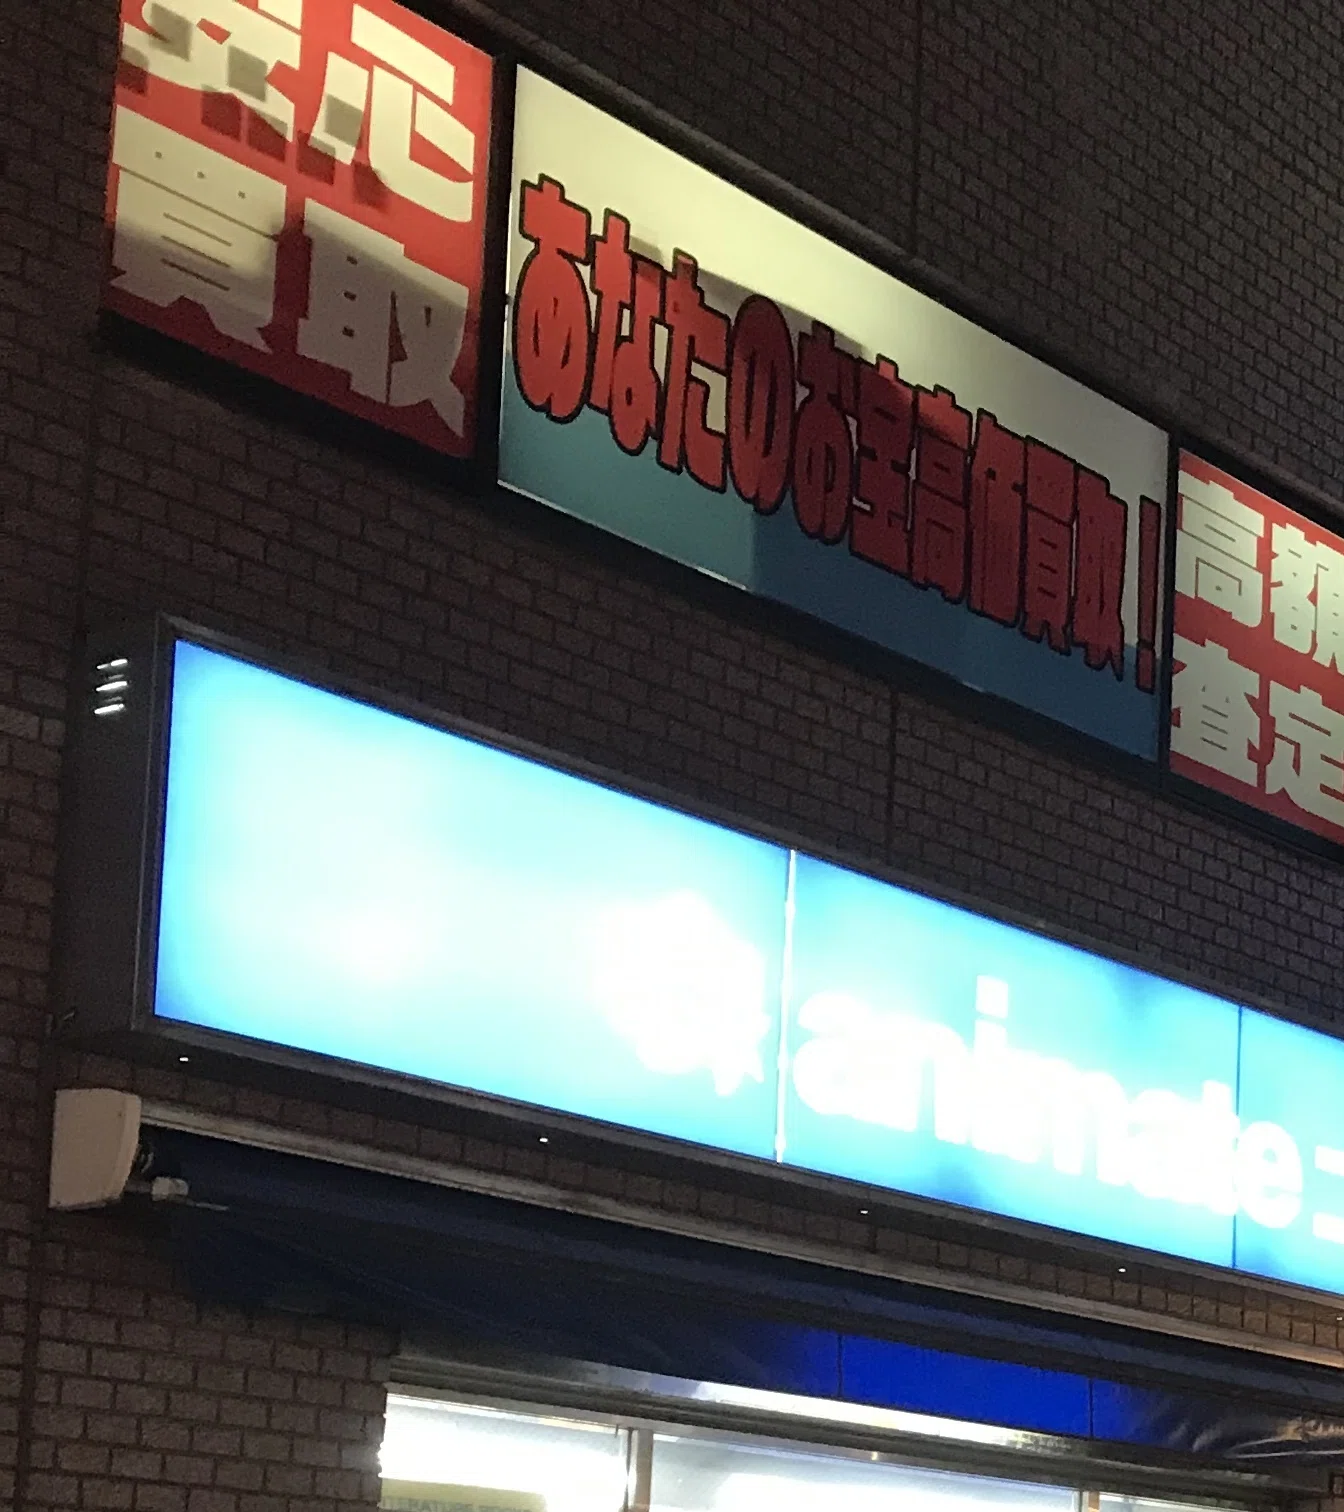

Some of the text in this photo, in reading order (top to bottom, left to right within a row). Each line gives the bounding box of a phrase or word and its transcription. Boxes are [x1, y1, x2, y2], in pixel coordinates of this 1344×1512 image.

[109, 105, 470, 437] 買取
[511, 174, 1162, 695] あなたのお宝高価買取!
[792, 973, 1303, 1229] animate
